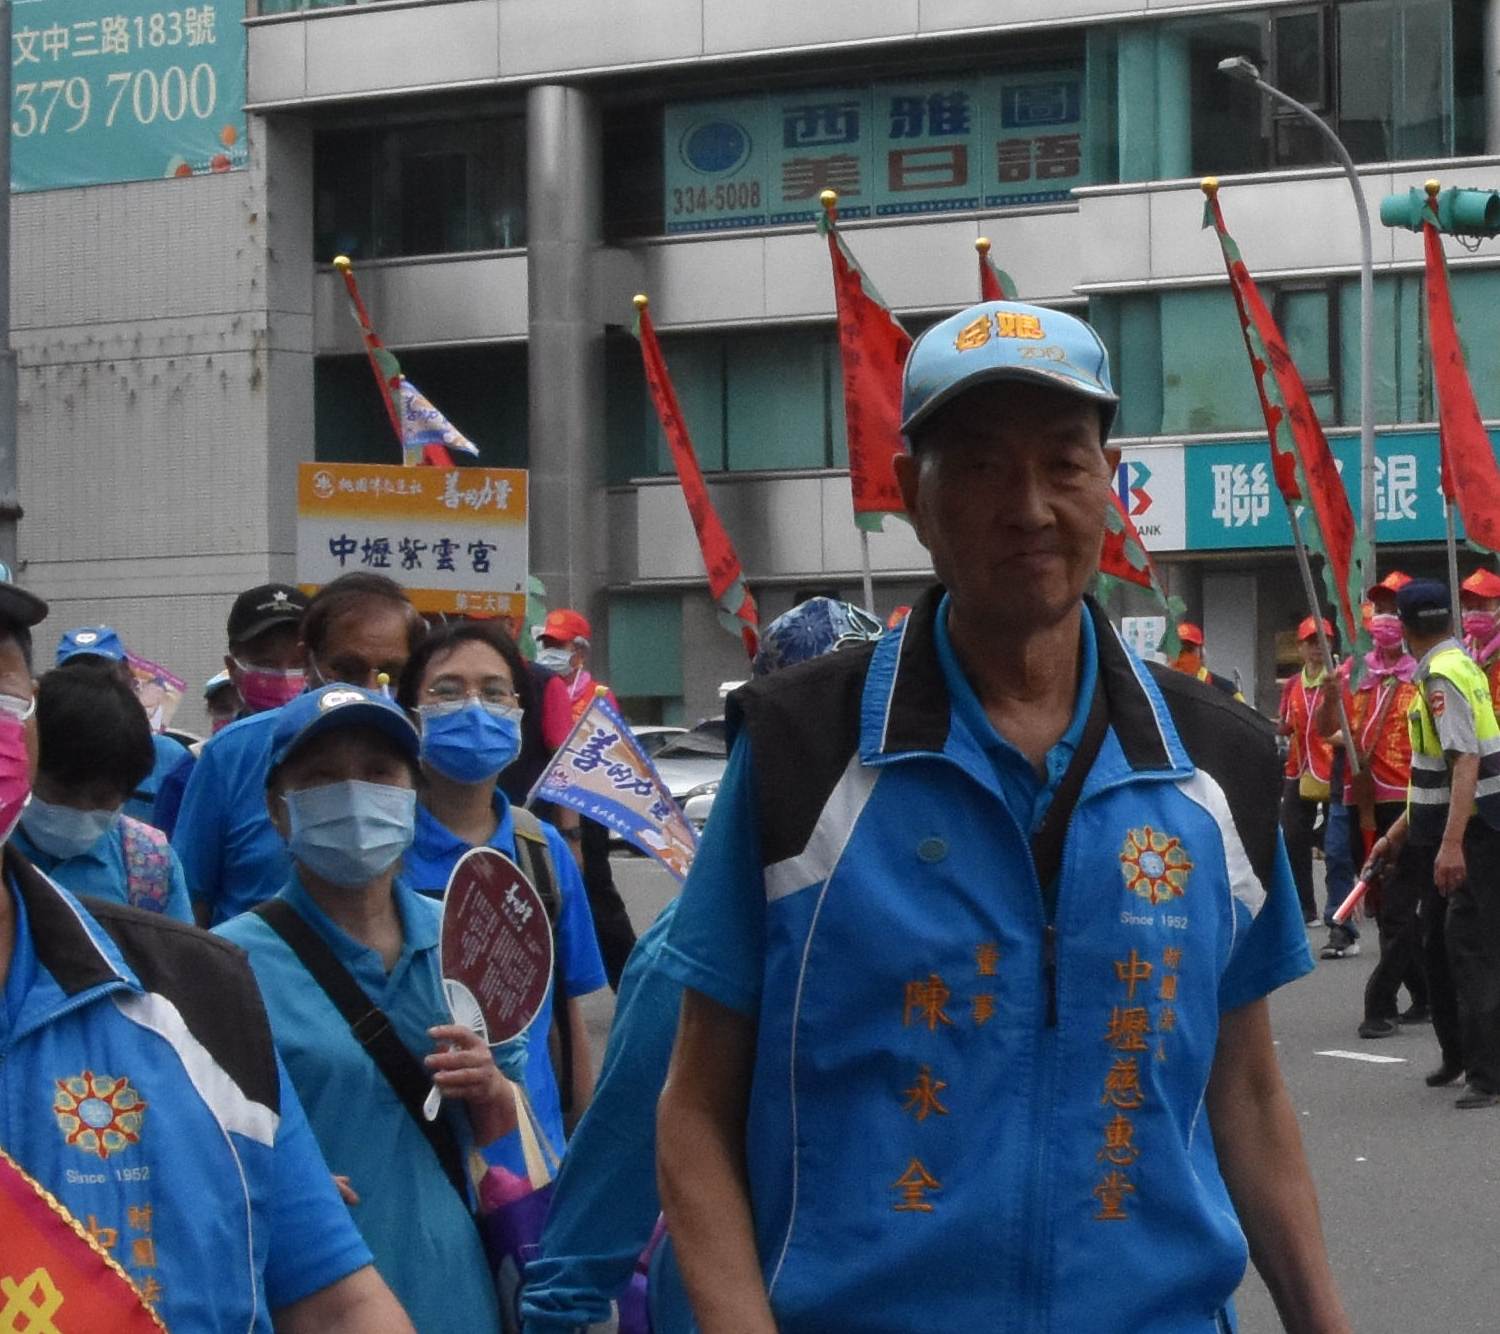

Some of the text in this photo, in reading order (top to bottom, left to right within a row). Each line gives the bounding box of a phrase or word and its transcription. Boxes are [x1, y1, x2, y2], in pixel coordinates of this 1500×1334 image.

[12, 5, 217, 66] 文中三路183號
[11, 63, 218, 138] 379 7000
[780, 79, 1083, 150] 西雅圖
[672, 181, 762, 216] 334-5008
[780, 133, 1083, 202] 美日語
[328, 533, 498, 574] 中壢紫雲宮
[1119, 910, 1189, 932] Since 1952
[969, 940, 1002, 1029] 董事
[888, 973, 954, 1215] 陳永全
[1092, 948, 1155, 1223] 中壢慈惠堂
[66, 1166, 151, 1185] Since 1952
